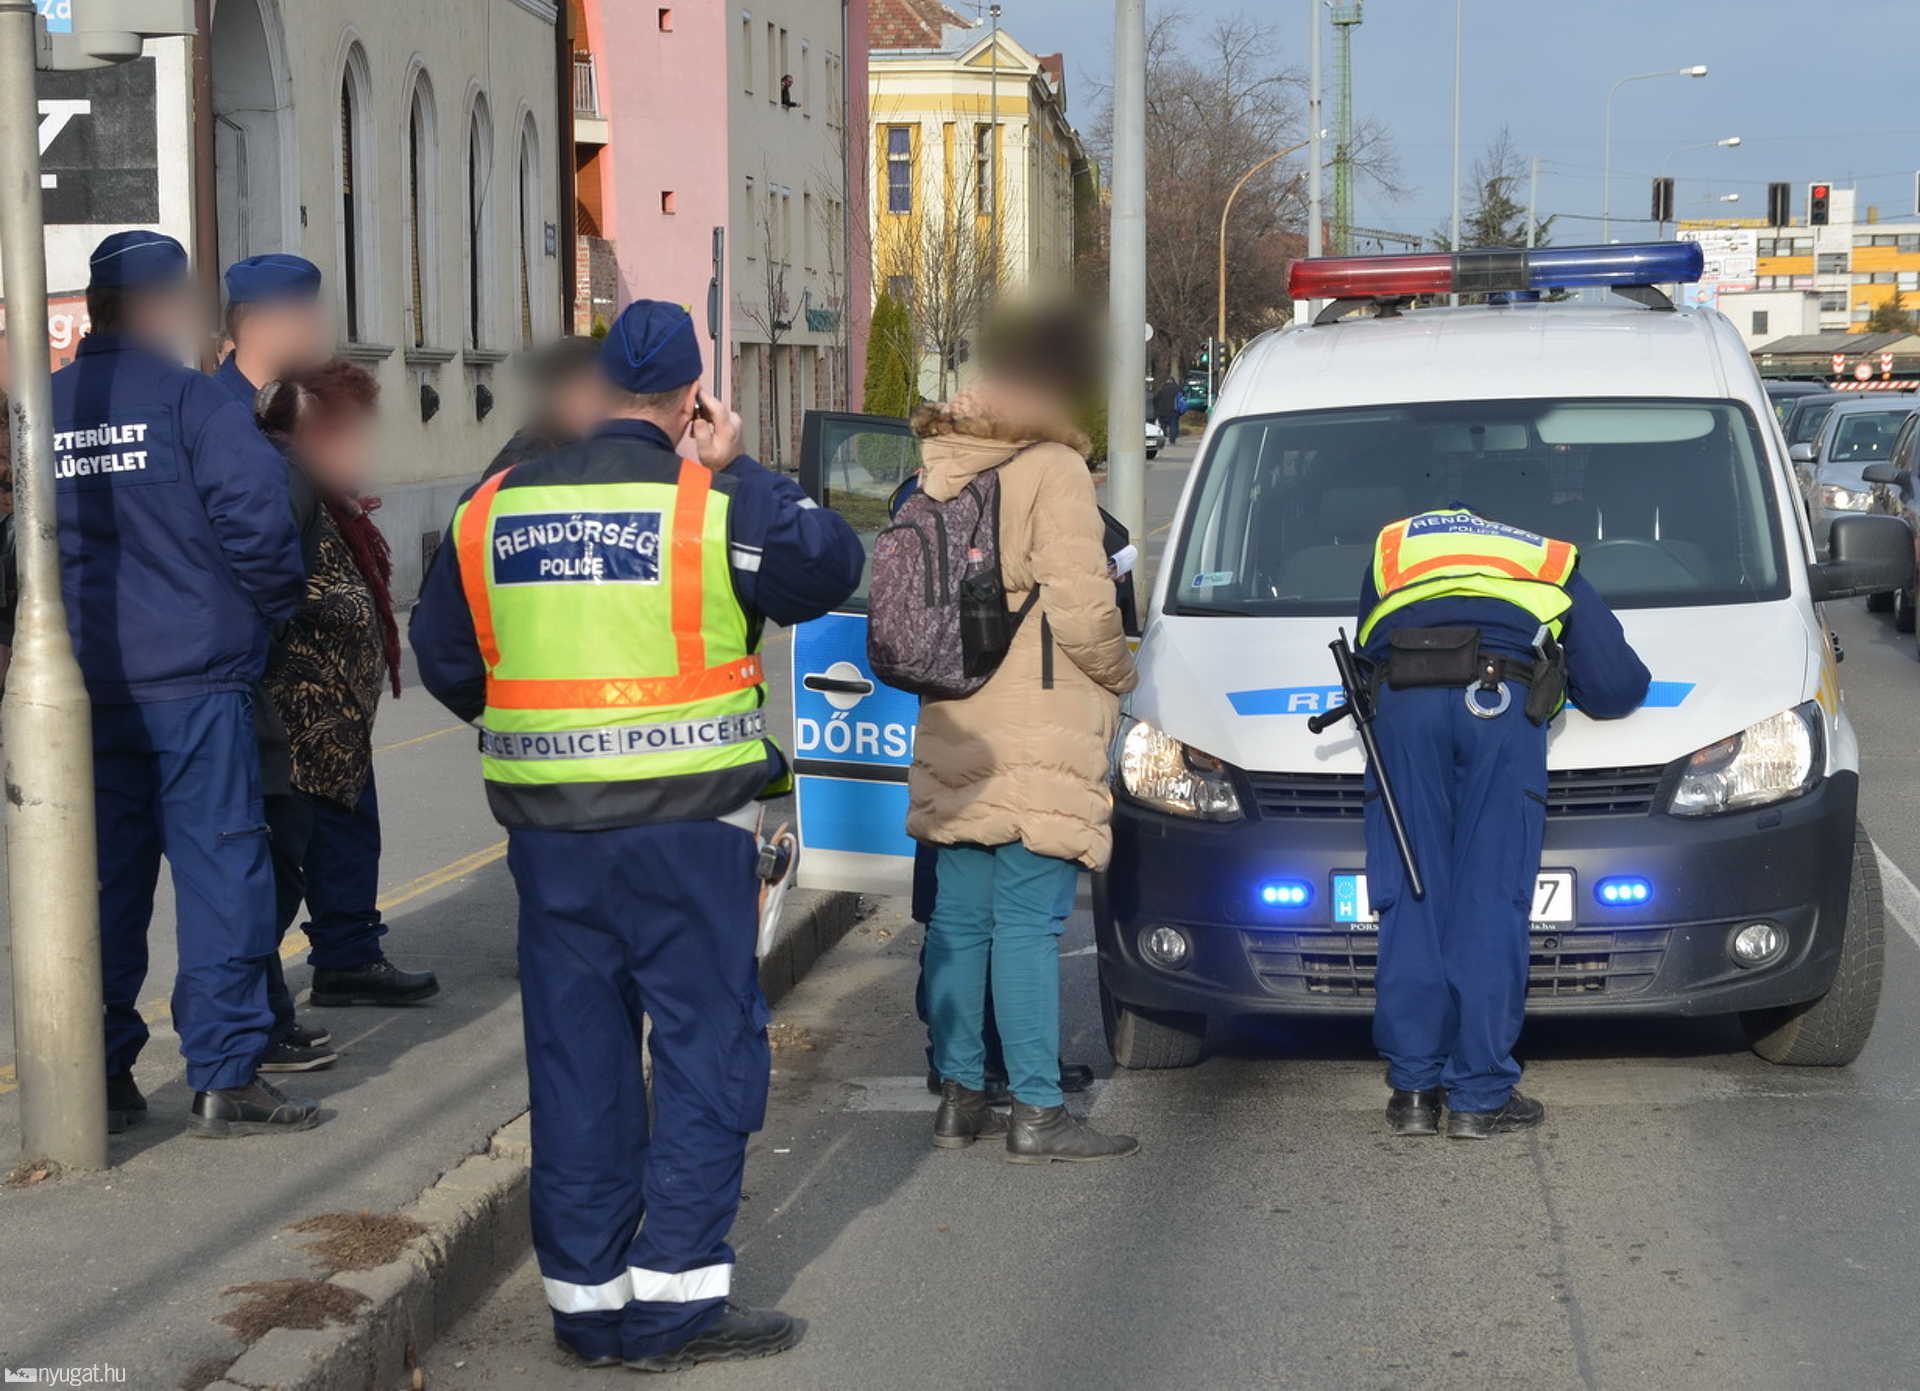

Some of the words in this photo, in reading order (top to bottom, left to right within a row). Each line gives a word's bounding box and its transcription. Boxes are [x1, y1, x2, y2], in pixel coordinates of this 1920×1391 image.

[495, 514, 655, 561] RENDŐRSÉG
[540, 557, 604, 577] POLICE
[522, 732, 612, 756] POLICE
[627, 720, 730, 751] POLICE
[797, 712, 916, 758] DŐRS
[1539, 880, 1560, 915] 7
